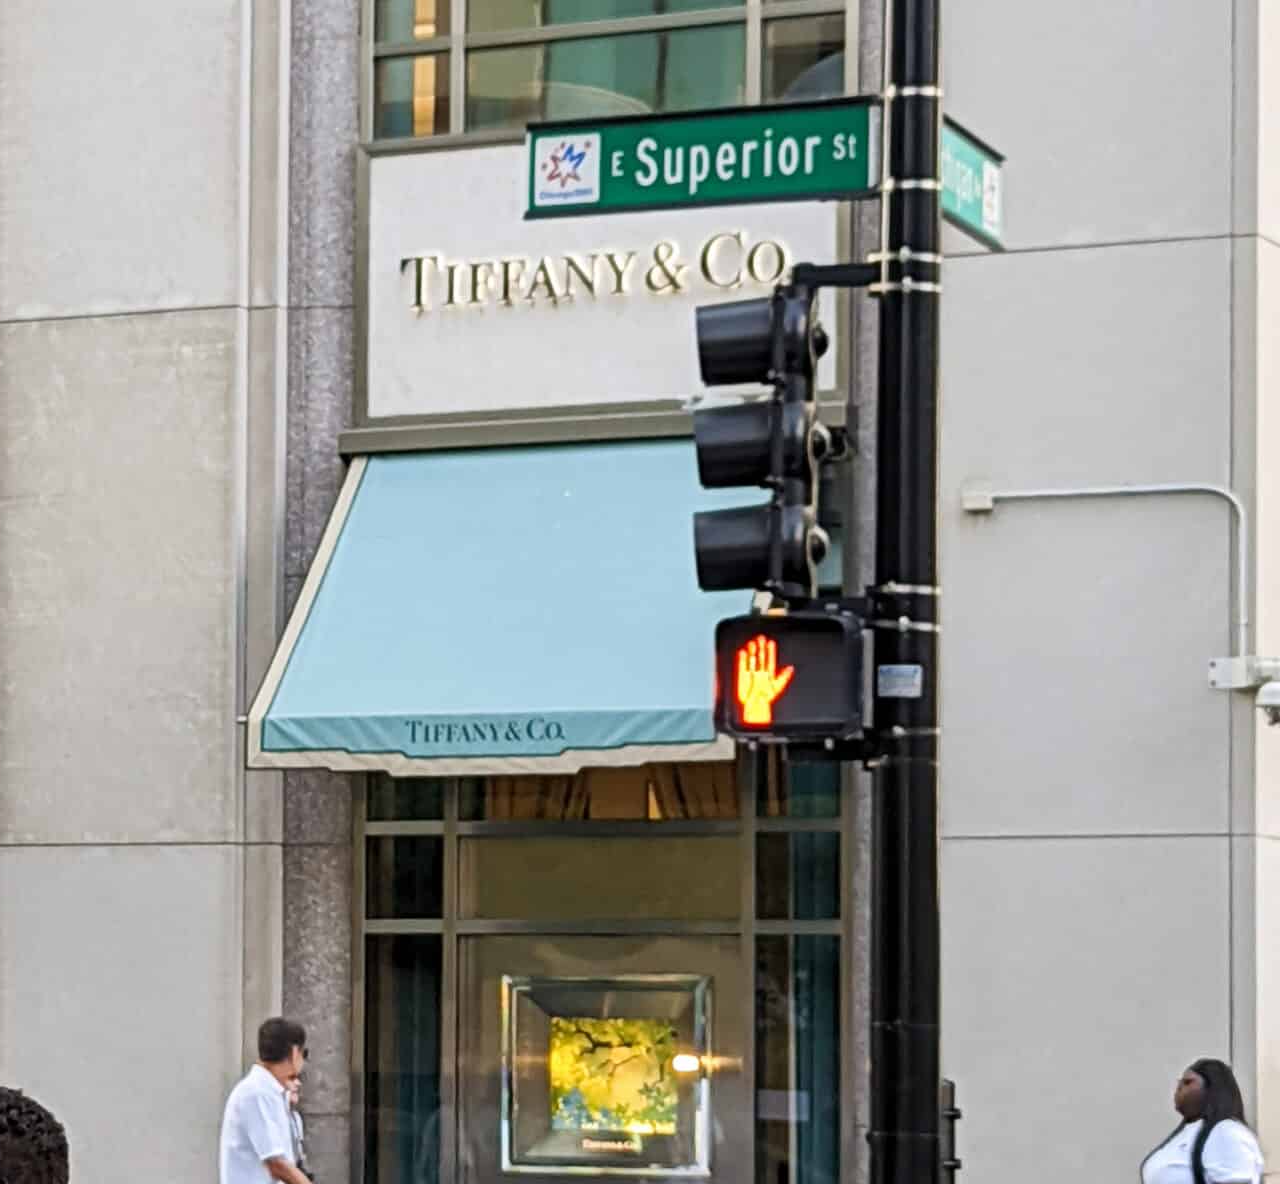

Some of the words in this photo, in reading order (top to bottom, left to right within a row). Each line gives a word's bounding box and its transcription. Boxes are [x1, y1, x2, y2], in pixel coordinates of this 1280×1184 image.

[611, 150, 625, 177] E
[634, 128, 822, 196] Superior
[832, 133, 857, 160] St
[399, 250, 638, 310] TIFFANY
[645, 239, 686, 294] &
[405, 719, 501, 744] TIFFANY
